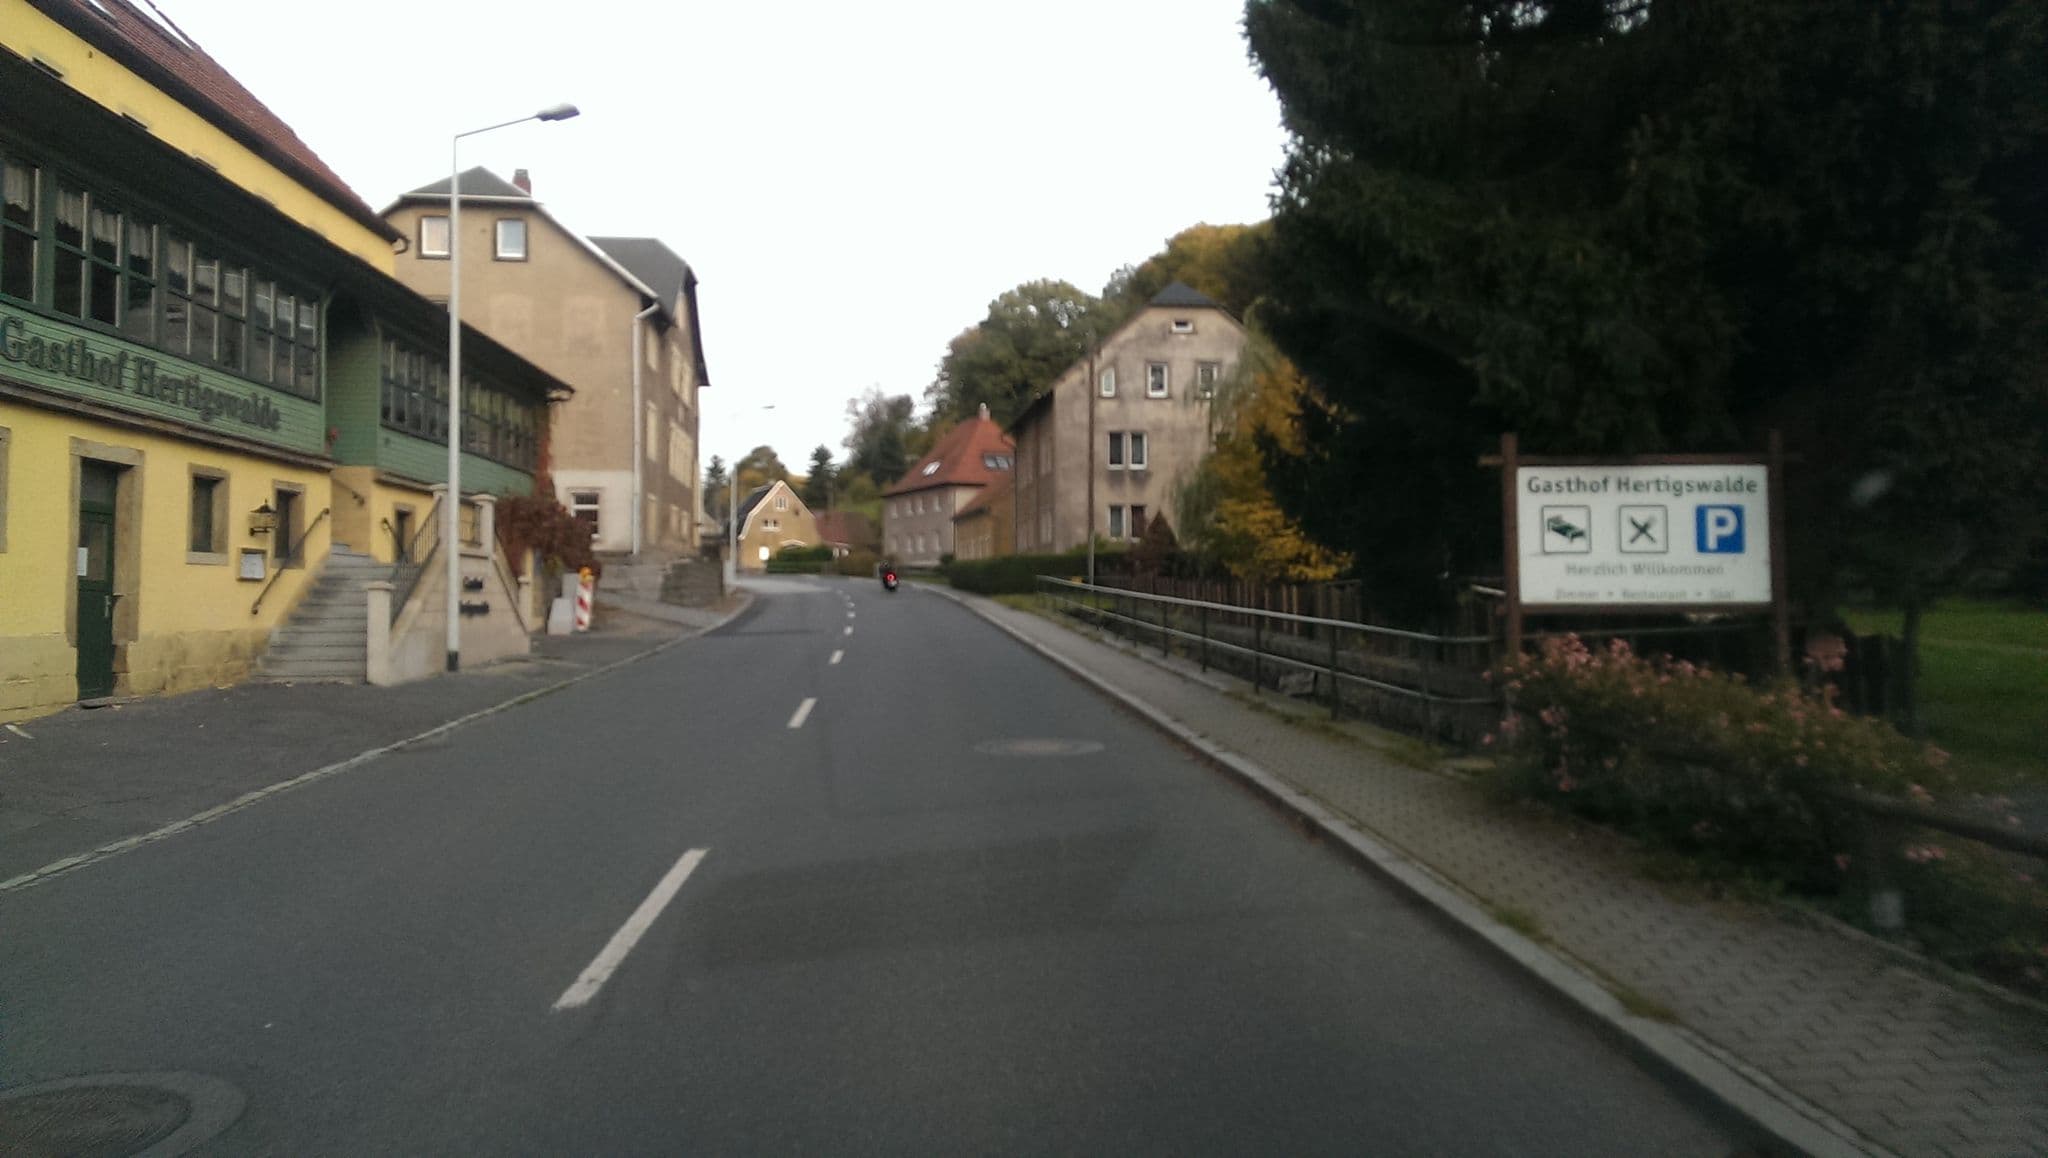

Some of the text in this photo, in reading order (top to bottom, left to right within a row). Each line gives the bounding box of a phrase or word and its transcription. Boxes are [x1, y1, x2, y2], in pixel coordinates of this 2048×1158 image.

[1, 316, 281, 431] Gasthof Hertigswalde
[1527, 475, 1759, 497] Gasthof Hertigswalde
[1705, 508, 1739, 551] P
[1565, 562, 1724, 577] Herzlich Willkommen
